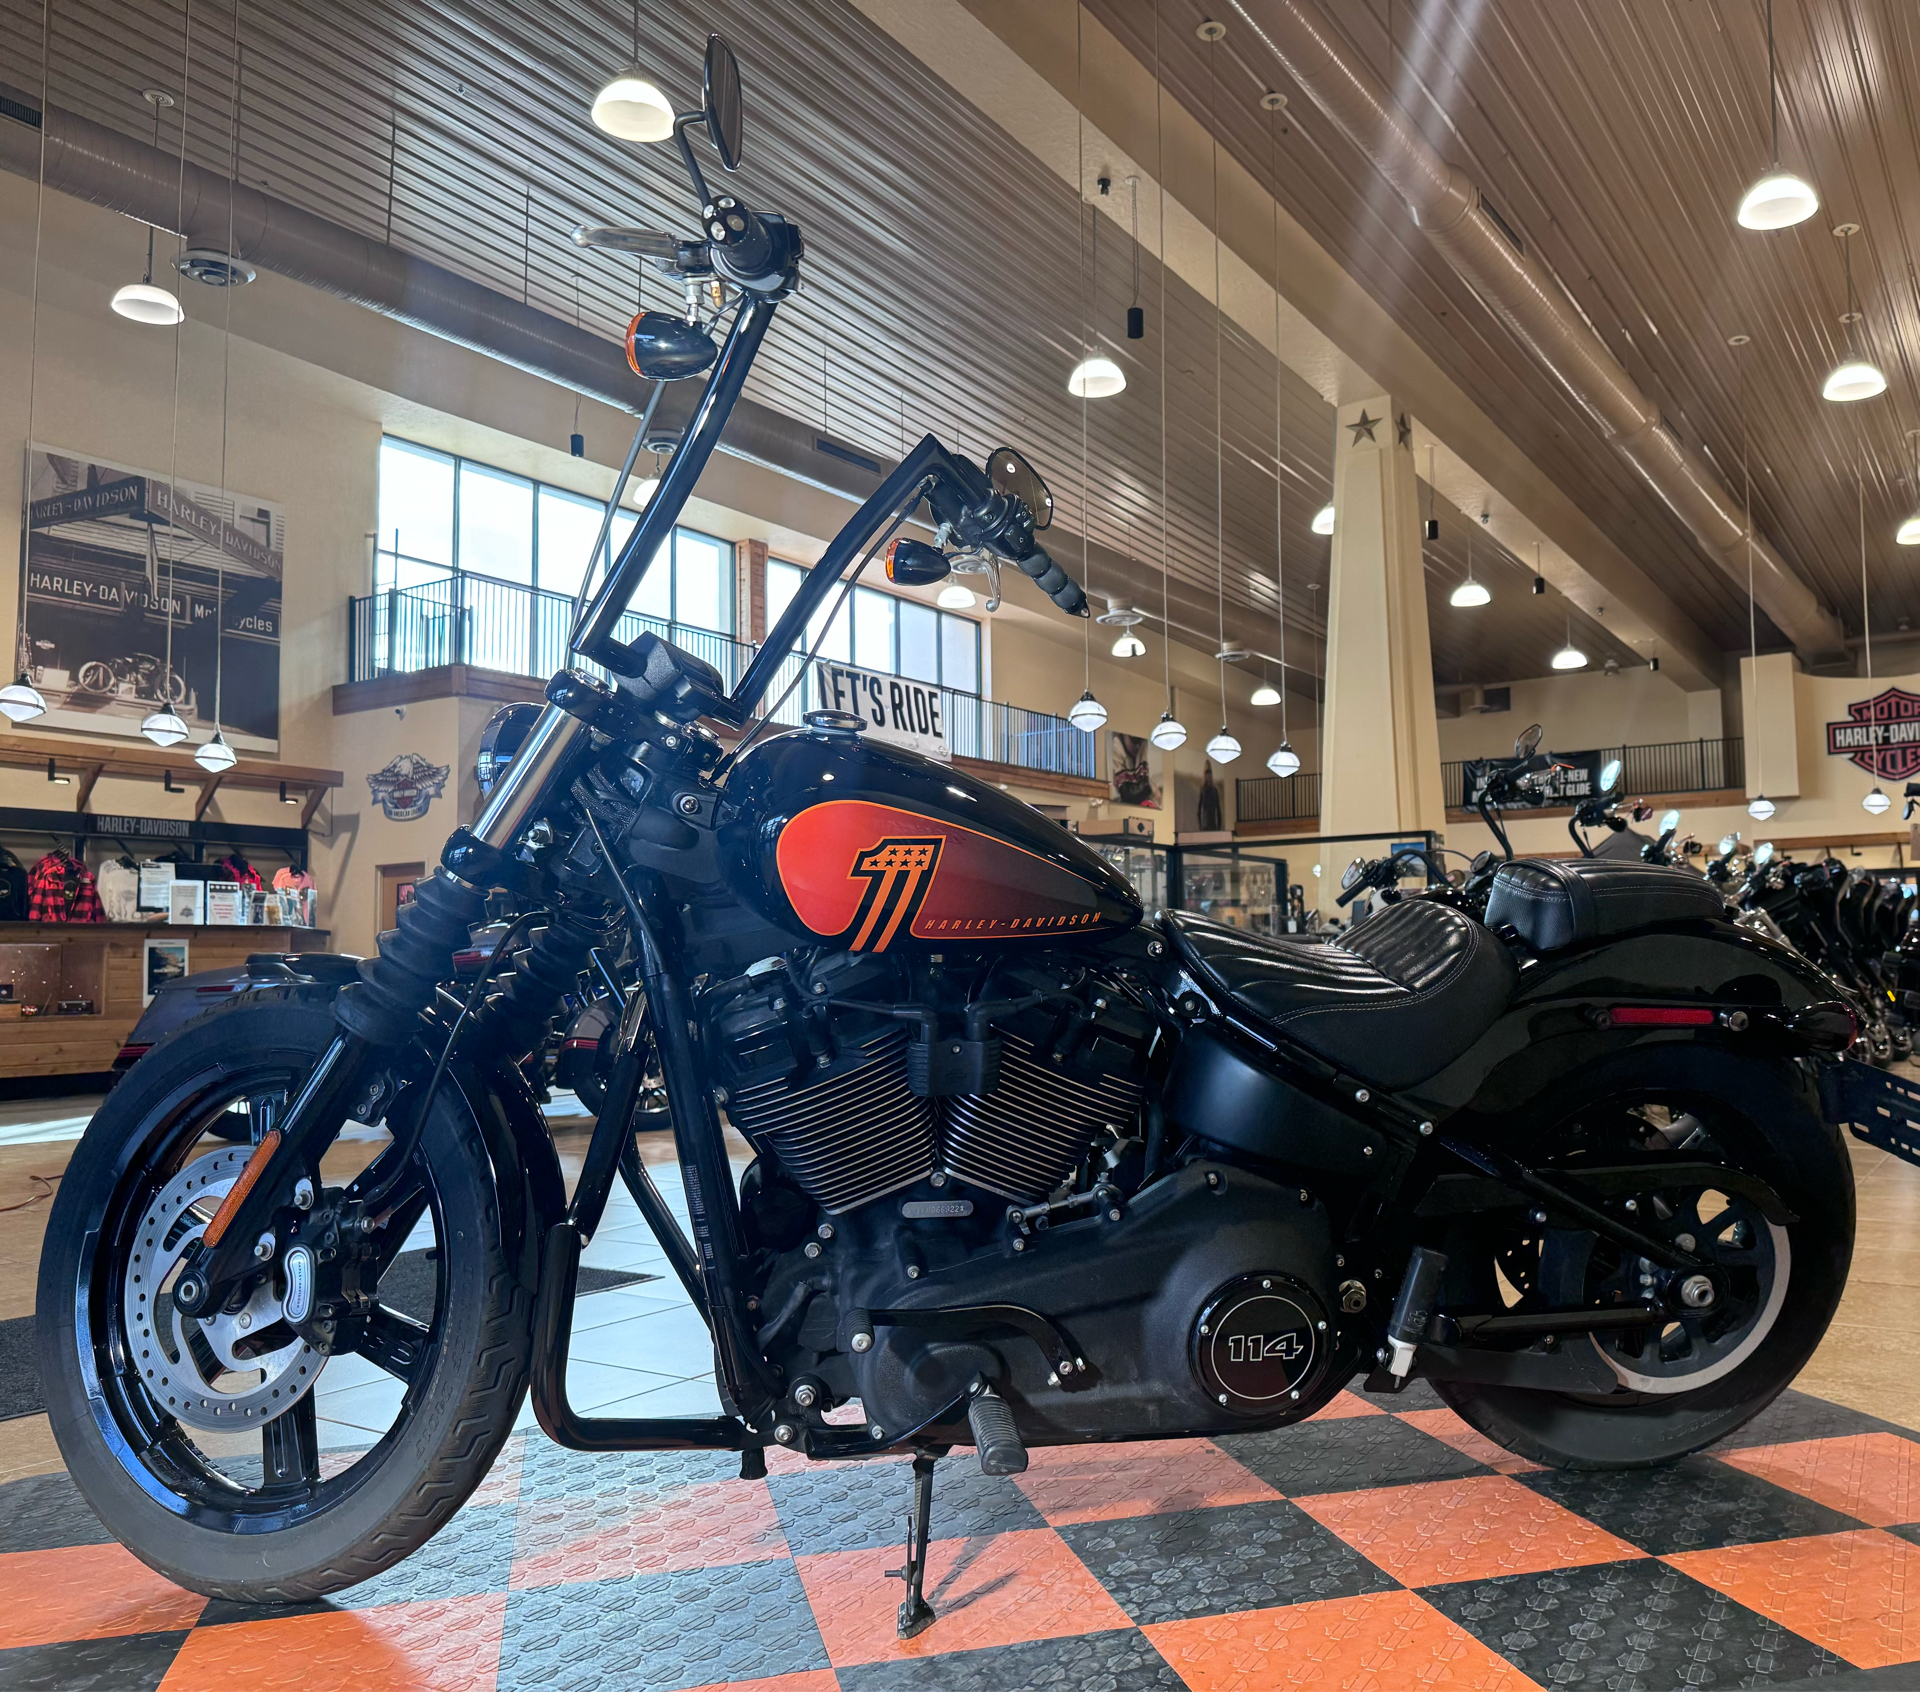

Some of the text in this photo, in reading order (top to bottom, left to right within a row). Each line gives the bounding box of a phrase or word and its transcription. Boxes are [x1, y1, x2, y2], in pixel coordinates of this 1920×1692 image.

[890, 681, 944, 738] RIDE
[1565, 781, 1592, 797] GLIDE
[97, 815, 190, 837] HARLEY-DAVIDSON
[925, 912, 1101, 930] HARLEY-DAVIDSON
[1228, 1332, 1304, 1361] 114
